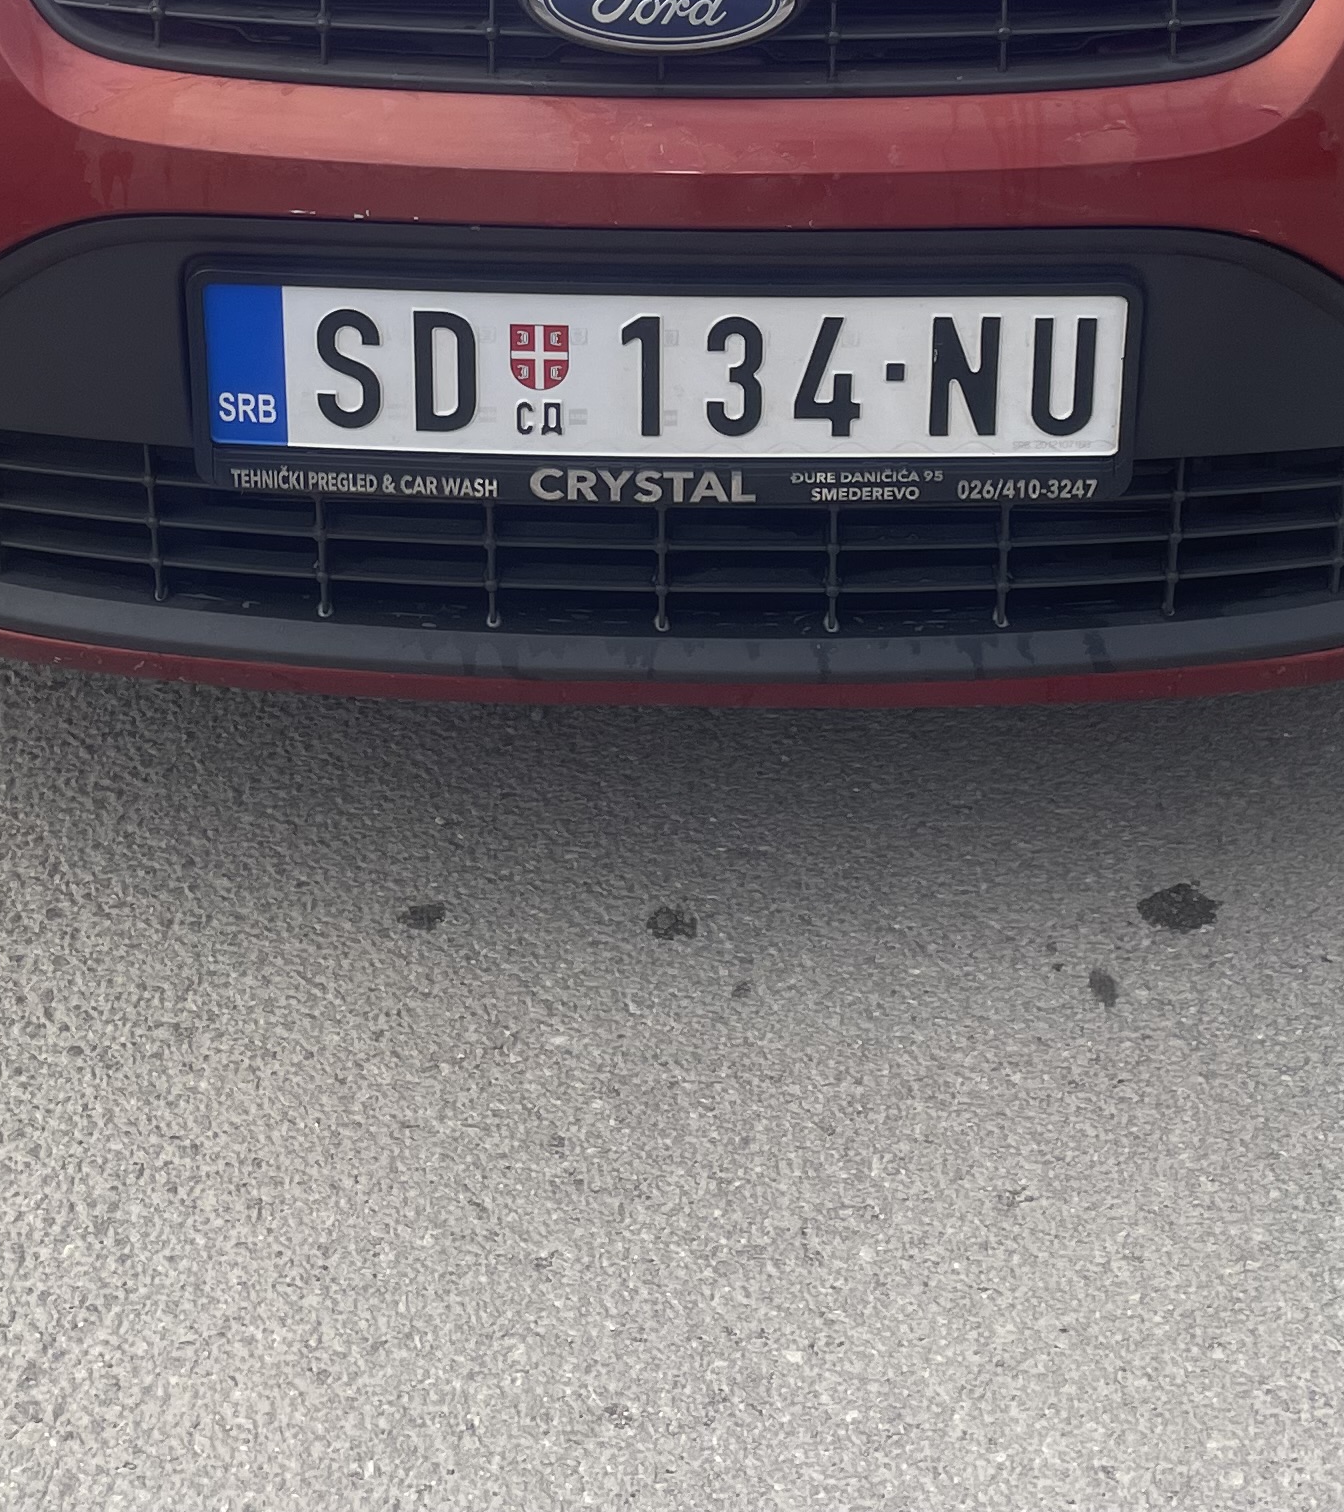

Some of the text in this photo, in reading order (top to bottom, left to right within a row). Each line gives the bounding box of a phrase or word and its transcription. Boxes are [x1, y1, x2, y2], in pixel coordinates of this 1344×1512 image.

[316, 308, 478, 432] SD
[218, 392, 277, 424] SRB
[230, 465, 498, 498] TEHNIČKI PREGLED & CAR WASH
[529, 467, 756, 503] CRYSTAL
[790, 468, 944, 484] ĐURE DANIČIĆA 95
[956, 478, 1099, 500] 026/410-3247
[810, 486, 921, 502] SMEDEREVO
